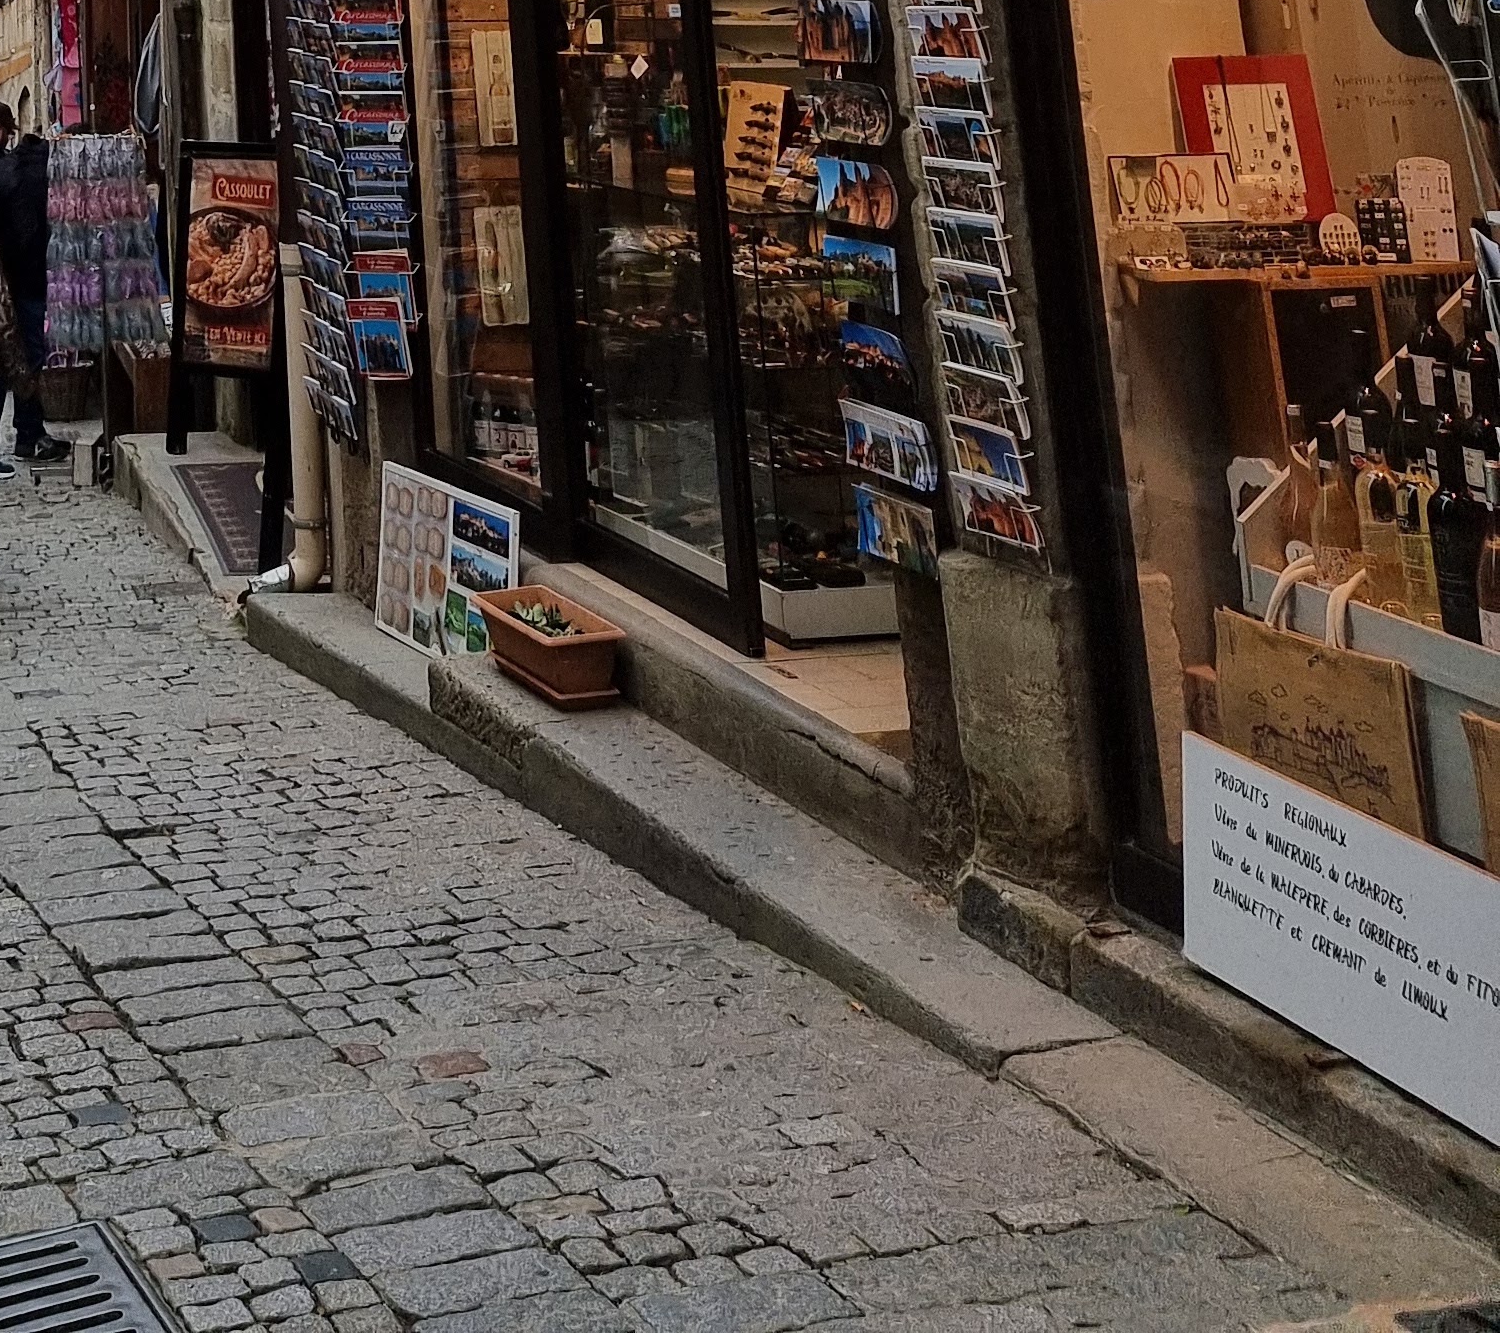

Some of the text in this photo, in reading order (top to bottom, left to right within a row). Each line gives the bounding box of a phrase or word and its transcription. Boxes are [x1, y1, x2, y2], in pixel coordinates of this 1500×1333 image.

[215, 177, 272, 201] CASSOULET
[1213, 767, 1348, 848] PRODUITS REGIONAUX
[1213, 802, 1238, 832] Vins
[1245, 822, 1258, 842] du
[1328, 864, 1340, 884] du
[1210, 838, 1234, 867] Vins
[1239, 857, 1253, 876] de
[1332, 904, 1352, 929] des
[1426, 958, 1442, 977] et
[1445, 963, 1459, 987] du
[1212, 877, 1450, 1023] BLANQUETTE et CREMANT de LIMOUX
